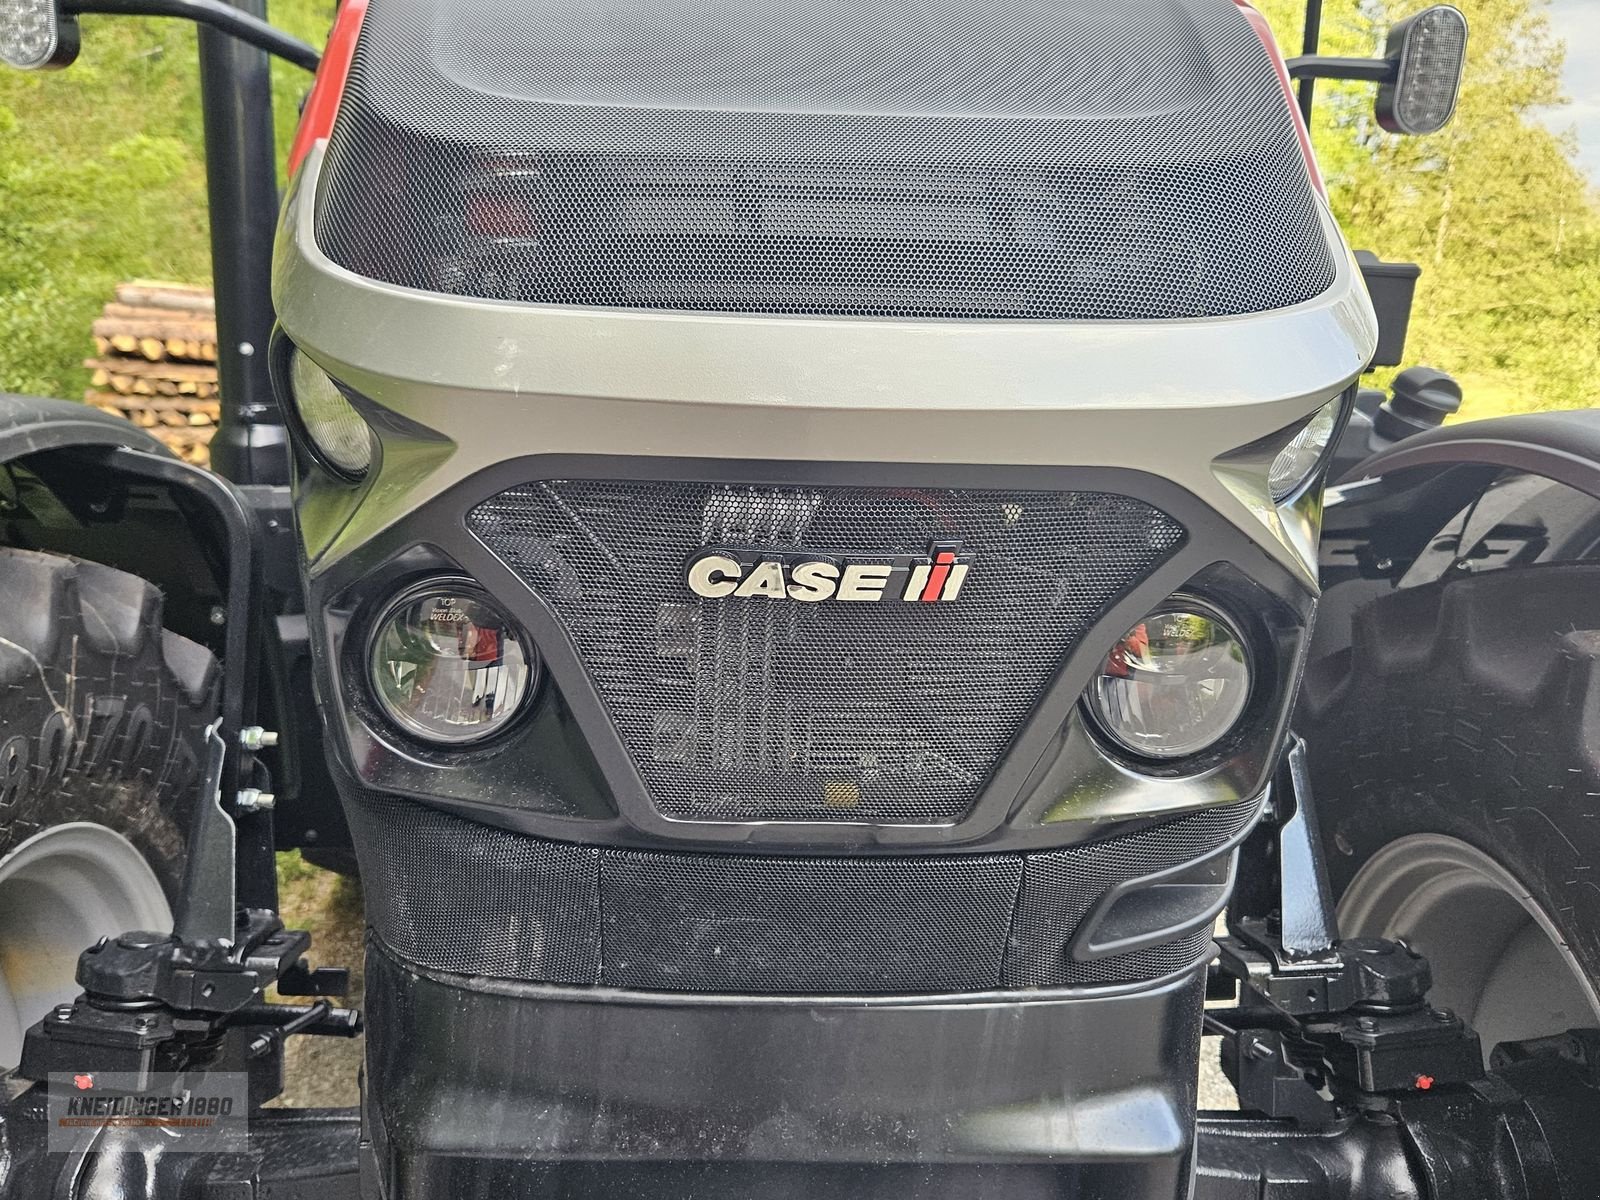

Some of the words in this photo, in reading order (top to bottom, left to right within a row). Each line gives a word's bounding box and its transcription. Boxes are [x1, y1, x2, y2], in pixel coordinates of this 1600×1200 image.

[688, 555, 892, 601] CASE
[440, 598, 456, 607] TOP
[430, 613, 464, 621] WELDEX
